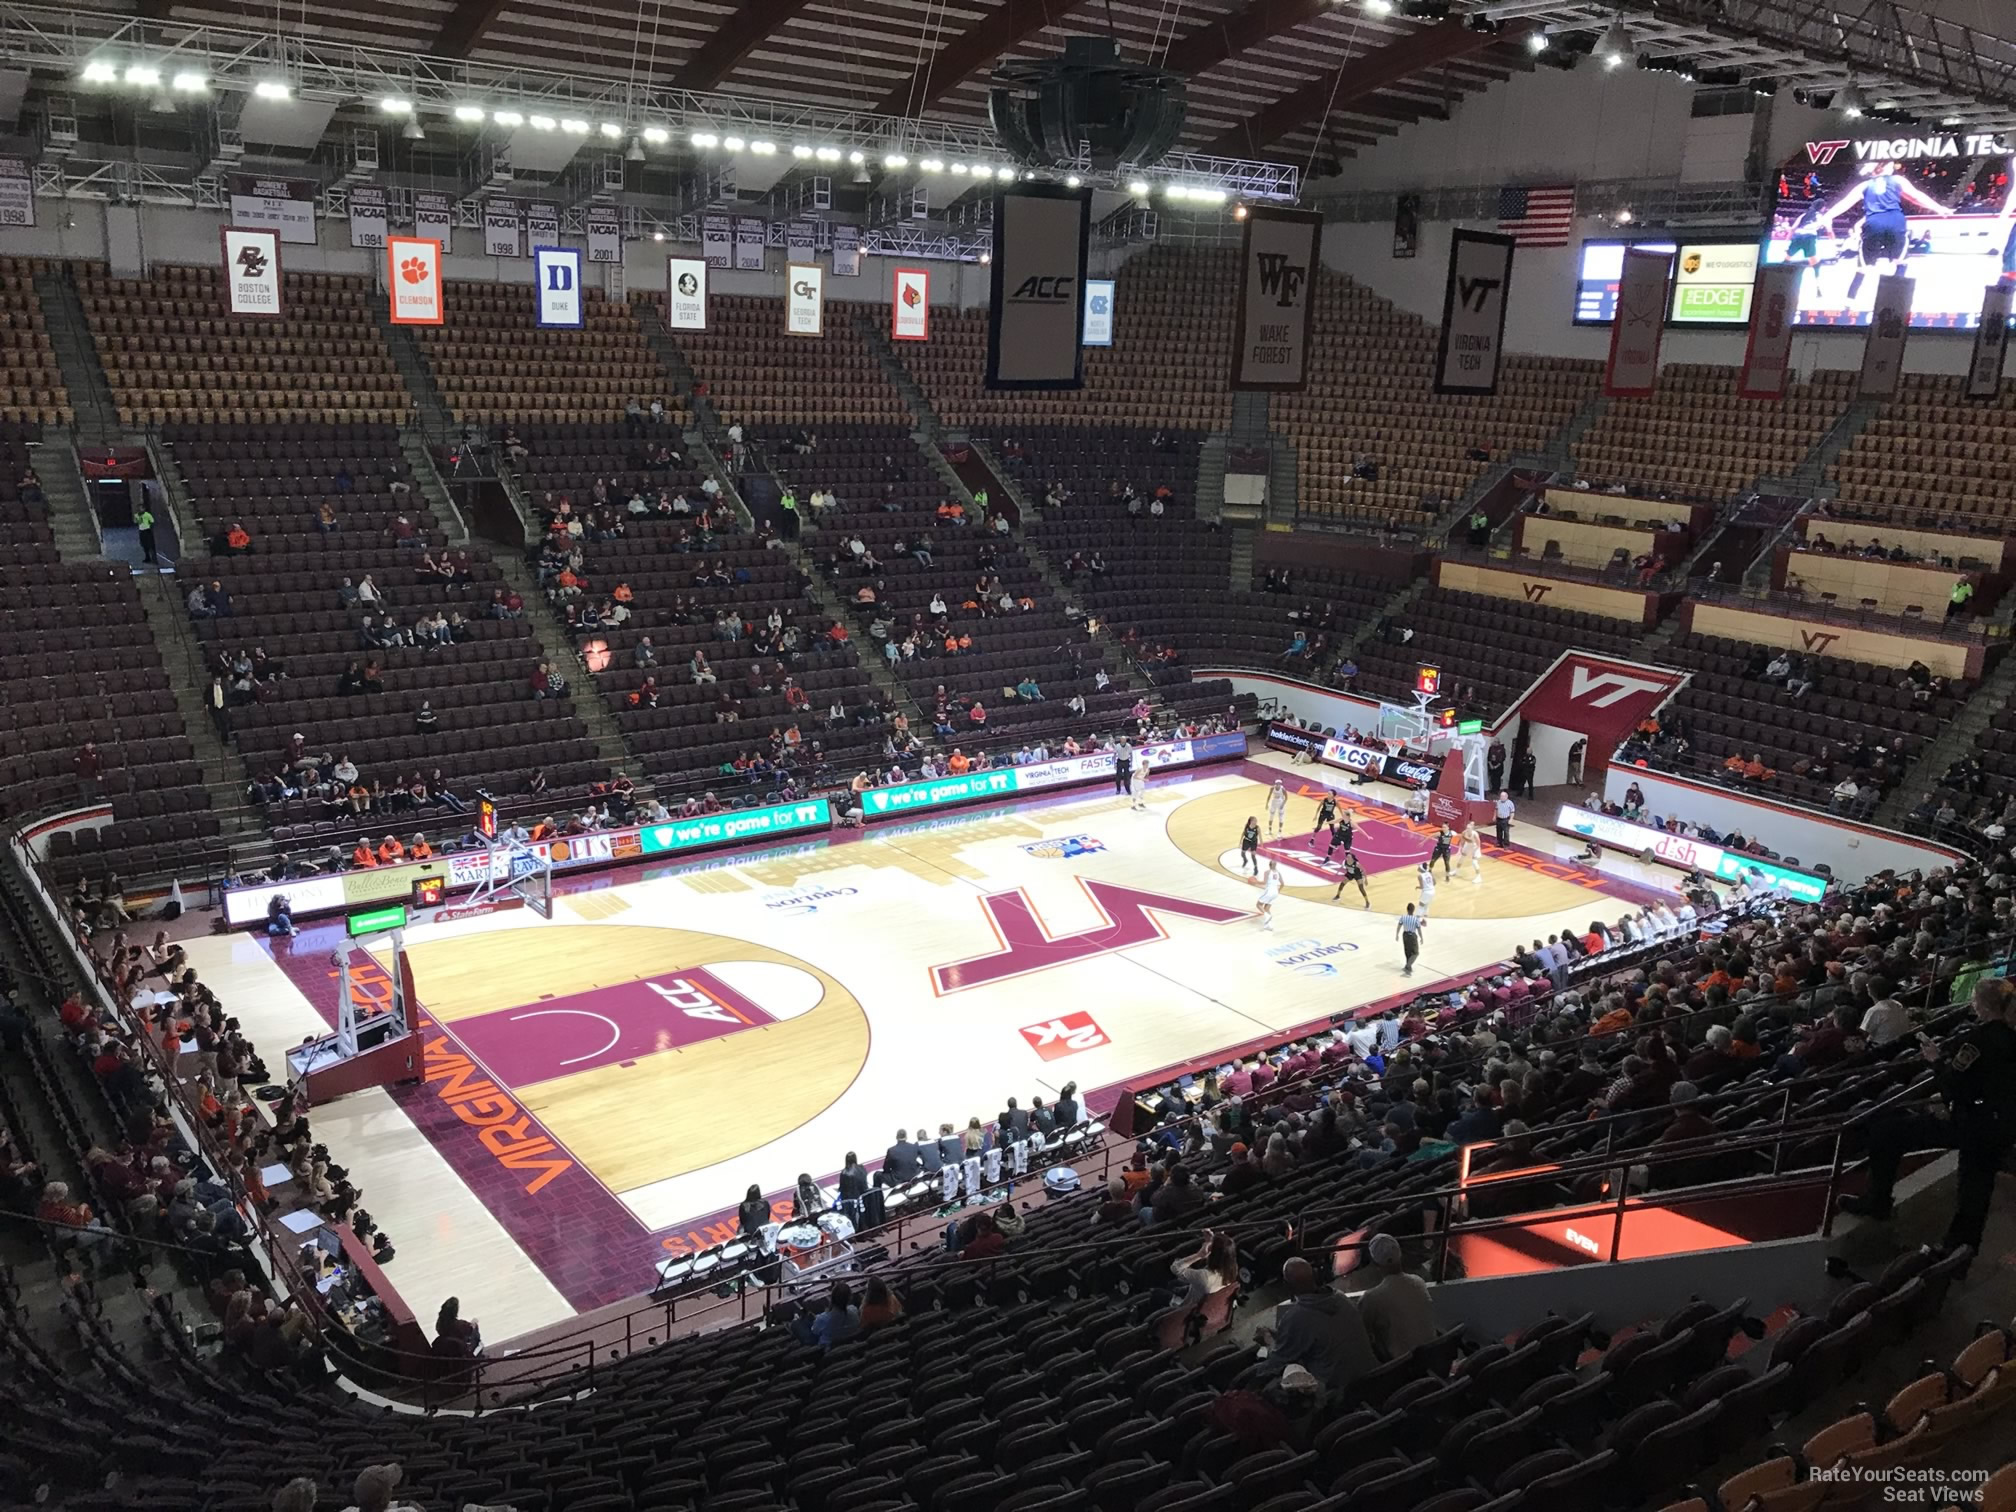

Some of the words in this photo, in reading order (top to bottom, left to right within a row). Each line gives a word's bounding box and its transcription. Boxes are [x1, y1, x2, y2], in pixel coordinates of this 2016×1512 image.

[1806, 141, 1849, 164] VT
[1855, 135, 1958, 161] VIRGINIA
[1966, 134, 2016, 156] TEC
[0, 209, 26, 223] 998
[353, 207, 385, 218] NCAA
[418, 213, 448, 224] NCAA
[488, 218, 516, 229] NCAA
[530, 221, 556, 231] NCAA
[590, 225, 617, 235] NCAA
[359, 234, 382, 245] 1994
[706, 232, 729, 242] NCAA
[739, 234, 762, 244] NCAA
[789, 239, 813, 248] NCAA
[492, 243, 513, 254] 1998
[594, 249, 613, 260] 2001
[709, 256, 727, 266] 2003
[1257, 253, 1305, 307] WF
[238, 283, 270, 293] BOSTON
[794, 281, 816, 300] GT
[1012, 276, 1074, 299] ACC
[1458, 275, 1501, 313] VT
[238, 294, 271, 304] COLLEGE
[400, 295, 432, 305] CLEMSON
[1694, 290, 1741, 305] EDGE
[551, 302, 568, 311] DUKE
[675, 302, 700, 312] FLORIDA
[793, 308, 815, 316] GEORGIA
[679, 311, 697, 321] STATE
[798, 316, 811, 325] TECH
[898, 315, 924, 325] LOUISVILLE
[1260, 324, 1289, 342] WAKE
[1455, 333, 1491, 351] VIRGINIA
[1253, 346, 1292, 364] FOREST
[1457, 353, 1481, 370] TECH
[1523, 582, 1552, 602] VT
[1801, 629, 1840, 653] VT
[1570, 665, 1671, 709] VT
[1081, 755, 1120, 771] FASTSI
[1024, 768, 1052, 780] VIRGINIA
[1053, 766, 1070, 776] TECH
[890, 788, 927, 806] we're
[930, 780, 968, 801] game
[970, 778, 987, 793] for
[675, 823, 721, 844] we're
[724, 814, 770, 837] game
[773, 809, 793, 825] for
[1655, 836, 1697, 866] dish
[455, 866, 503, 885] MARTN
[765, 887, 858, 909] CARILION
[1275, 942, 1359, 967] CARILION
[645, 979, 742, 1024] ACC
[1023, 1021, 1104, 1049] 2K
[1566, 1228, 1598, 1254] EVEN
